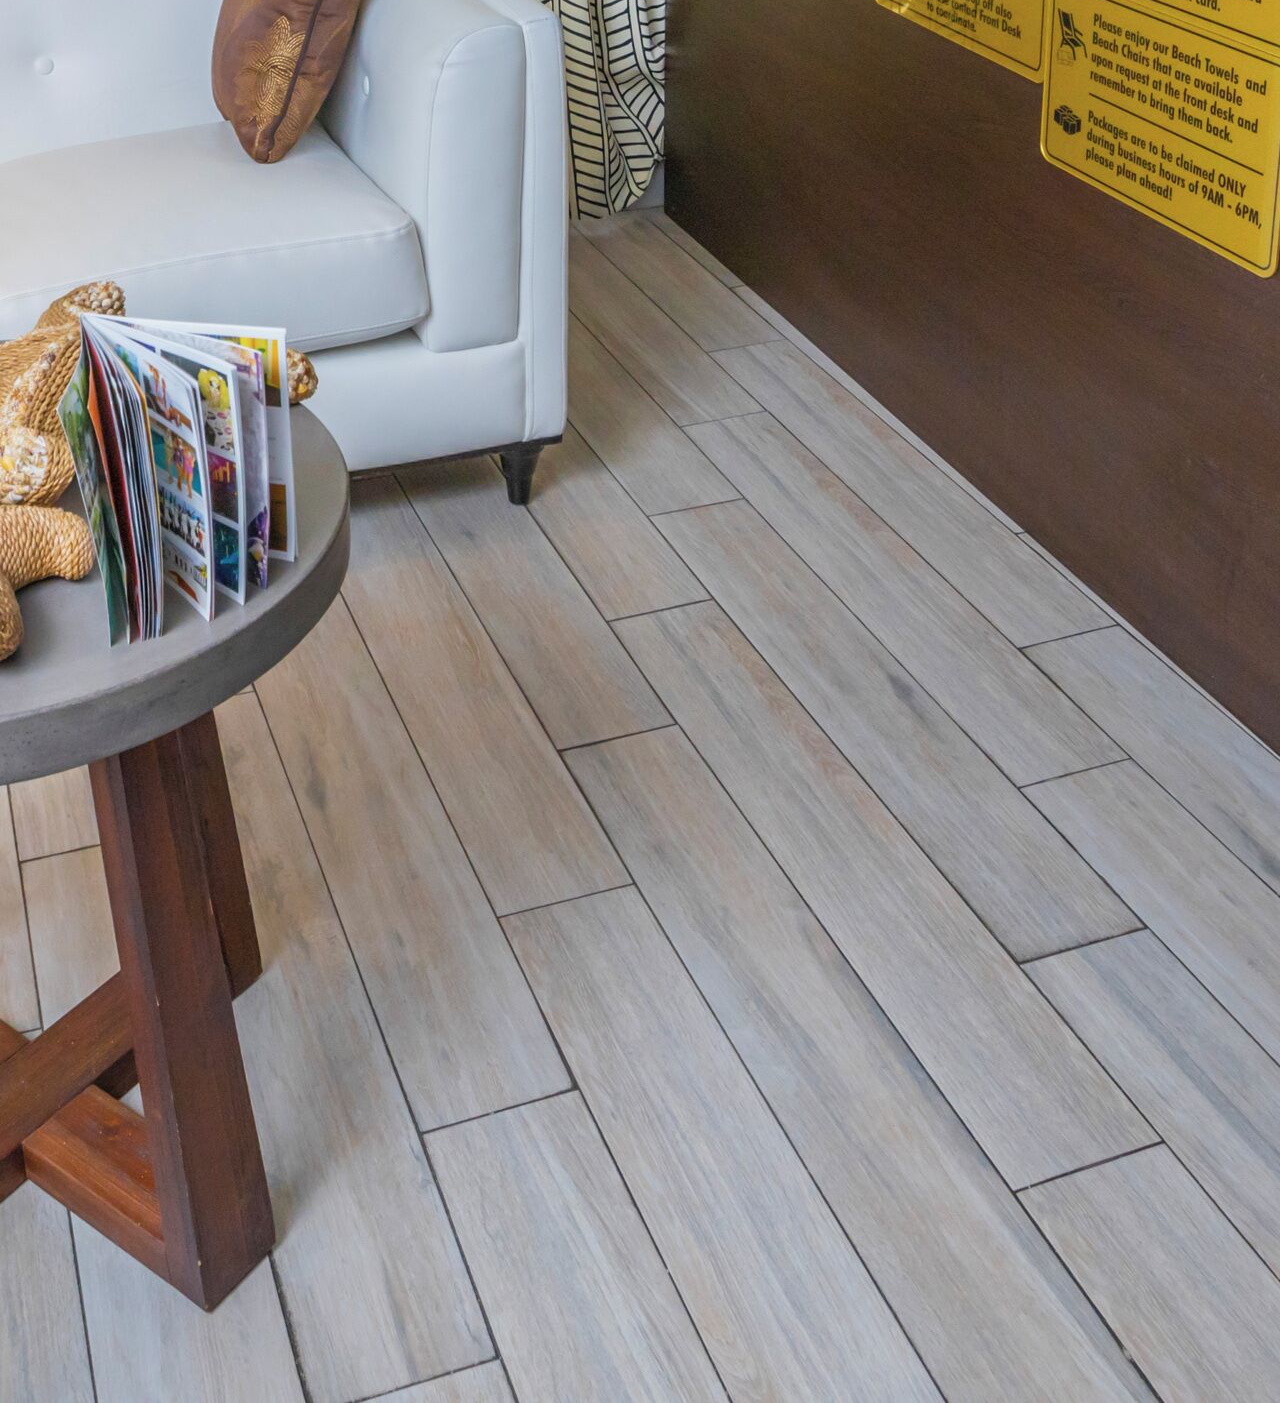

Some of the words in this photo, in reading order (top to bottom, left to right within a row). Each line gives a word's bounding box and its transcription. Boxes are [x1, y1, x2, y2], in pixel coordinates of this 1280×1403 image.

[927, 0, 933, 12] to
[979, 9, 998, 28] Front
[1001, 17, 1021, 39] Desk
[995, 0, 1011, 19] also
[1092, 31, 1118, 54] Beach
[1121, 44, 1150, 67] Chairs
[1152, 57, 1172, 76] that
[1174, 70, 1191, 84] are
[1194, 78, 1242, 106] available
[1093, 13, 1122, 37] Please
[1124, 30, 1150, 51] enjoy
[1152, 41, 1169, 56] our
[1171, 44, 1201, 70] Beach
[1204, 57, 1239, 84] Towels
[1245, 79, 1267, 96] and
[1090, 70, 1135, 98] remember
[1138, 90, 1147, 104] to
[1150, 93, 1175, 120] bring
[1178, 106, 1202, 130] them
[1206, 118, 1232, 143] back.
[1091, 53, 1113, 70] upon
[1115, 64, 1150, 86] request
[1152, 79, 1162, 92] at
[1164, 81, 1180, 100] the
[1183, 88, 1207, 112] front
[1210, 100, 1234, 124] desk
[1237, 116, 1258, 134] and
[1086, 147, 1114, 170] please
[1116, 163, 1136, 182] plan
[1139, 174, 1172, 201] ahead!
[1086, 128, 1115, 156] during
[1117, 142, 1156, 174] business
[1159, 162, 1186, 188] hours
[1188, 180, 1199, 195] of
[1201, 184, 1224, 208] 9AM
[1235, 202, 1262, 229] 6PM,
[1088, 110, 1128, 141] Packages
[1130, 135, 1146, 150] are
[1149, 141, 1158, 156] to
[1160, 144, 1172, 163] be
[1176, 154, 1215, 183] claimed
[1218, 173, 1246, 198] ONLY
